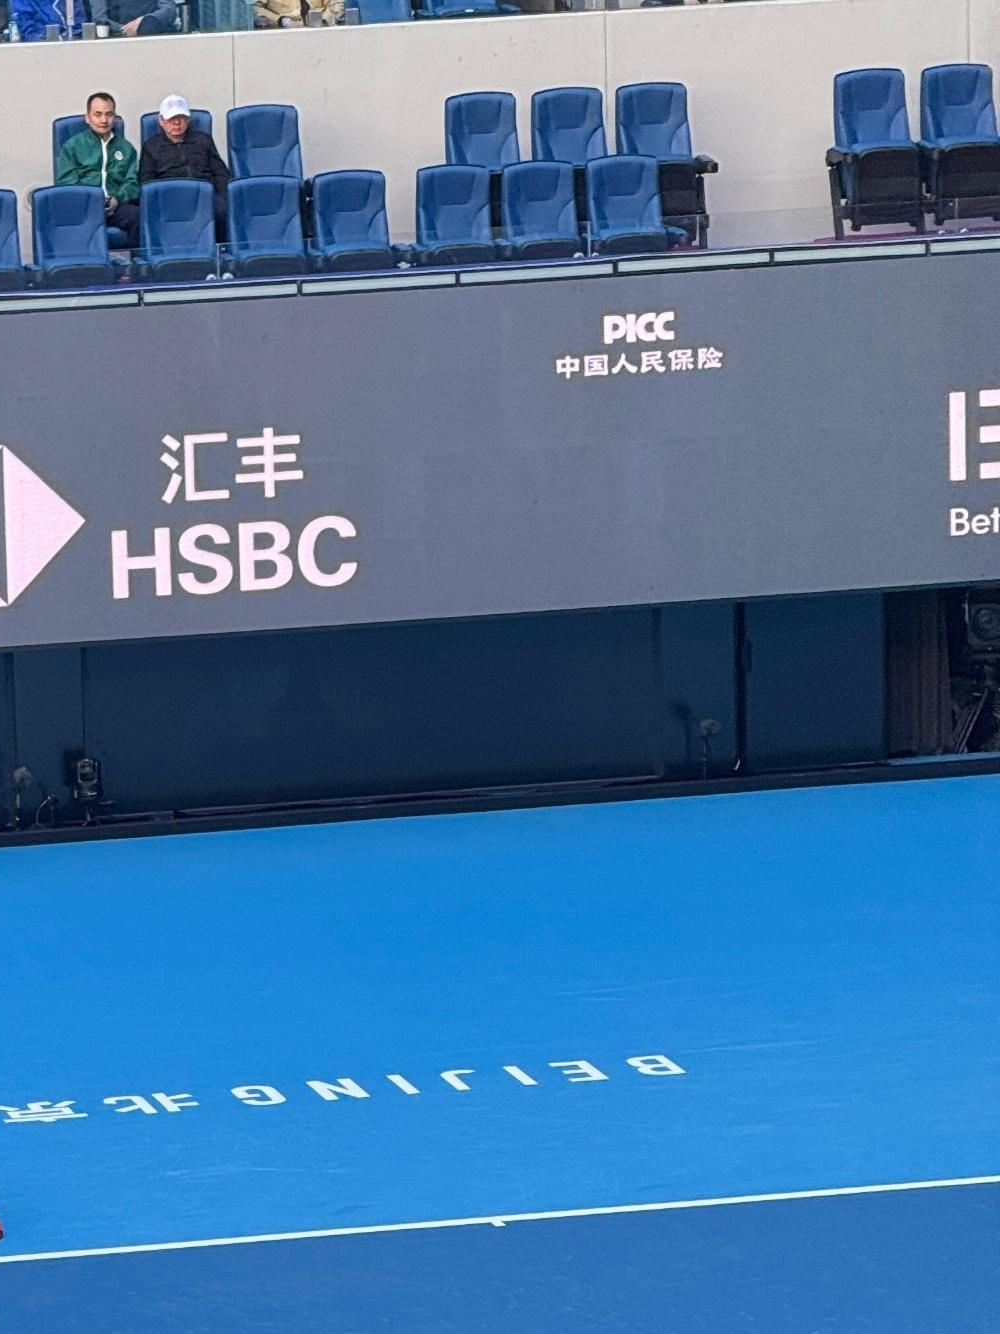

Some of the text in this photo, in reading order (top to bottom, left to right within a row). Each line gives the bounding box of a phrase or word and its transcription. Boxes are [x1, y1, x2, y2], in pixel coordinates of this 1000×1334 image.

[603, 311, 675, 345] PICC
[555, 346, 724, 380] 中国人民保险
[159, 426, 304, 504] 汇丰
[110, 515, 359, 600] HSBC
[229, 1054, 686, 1106] BEIJING
